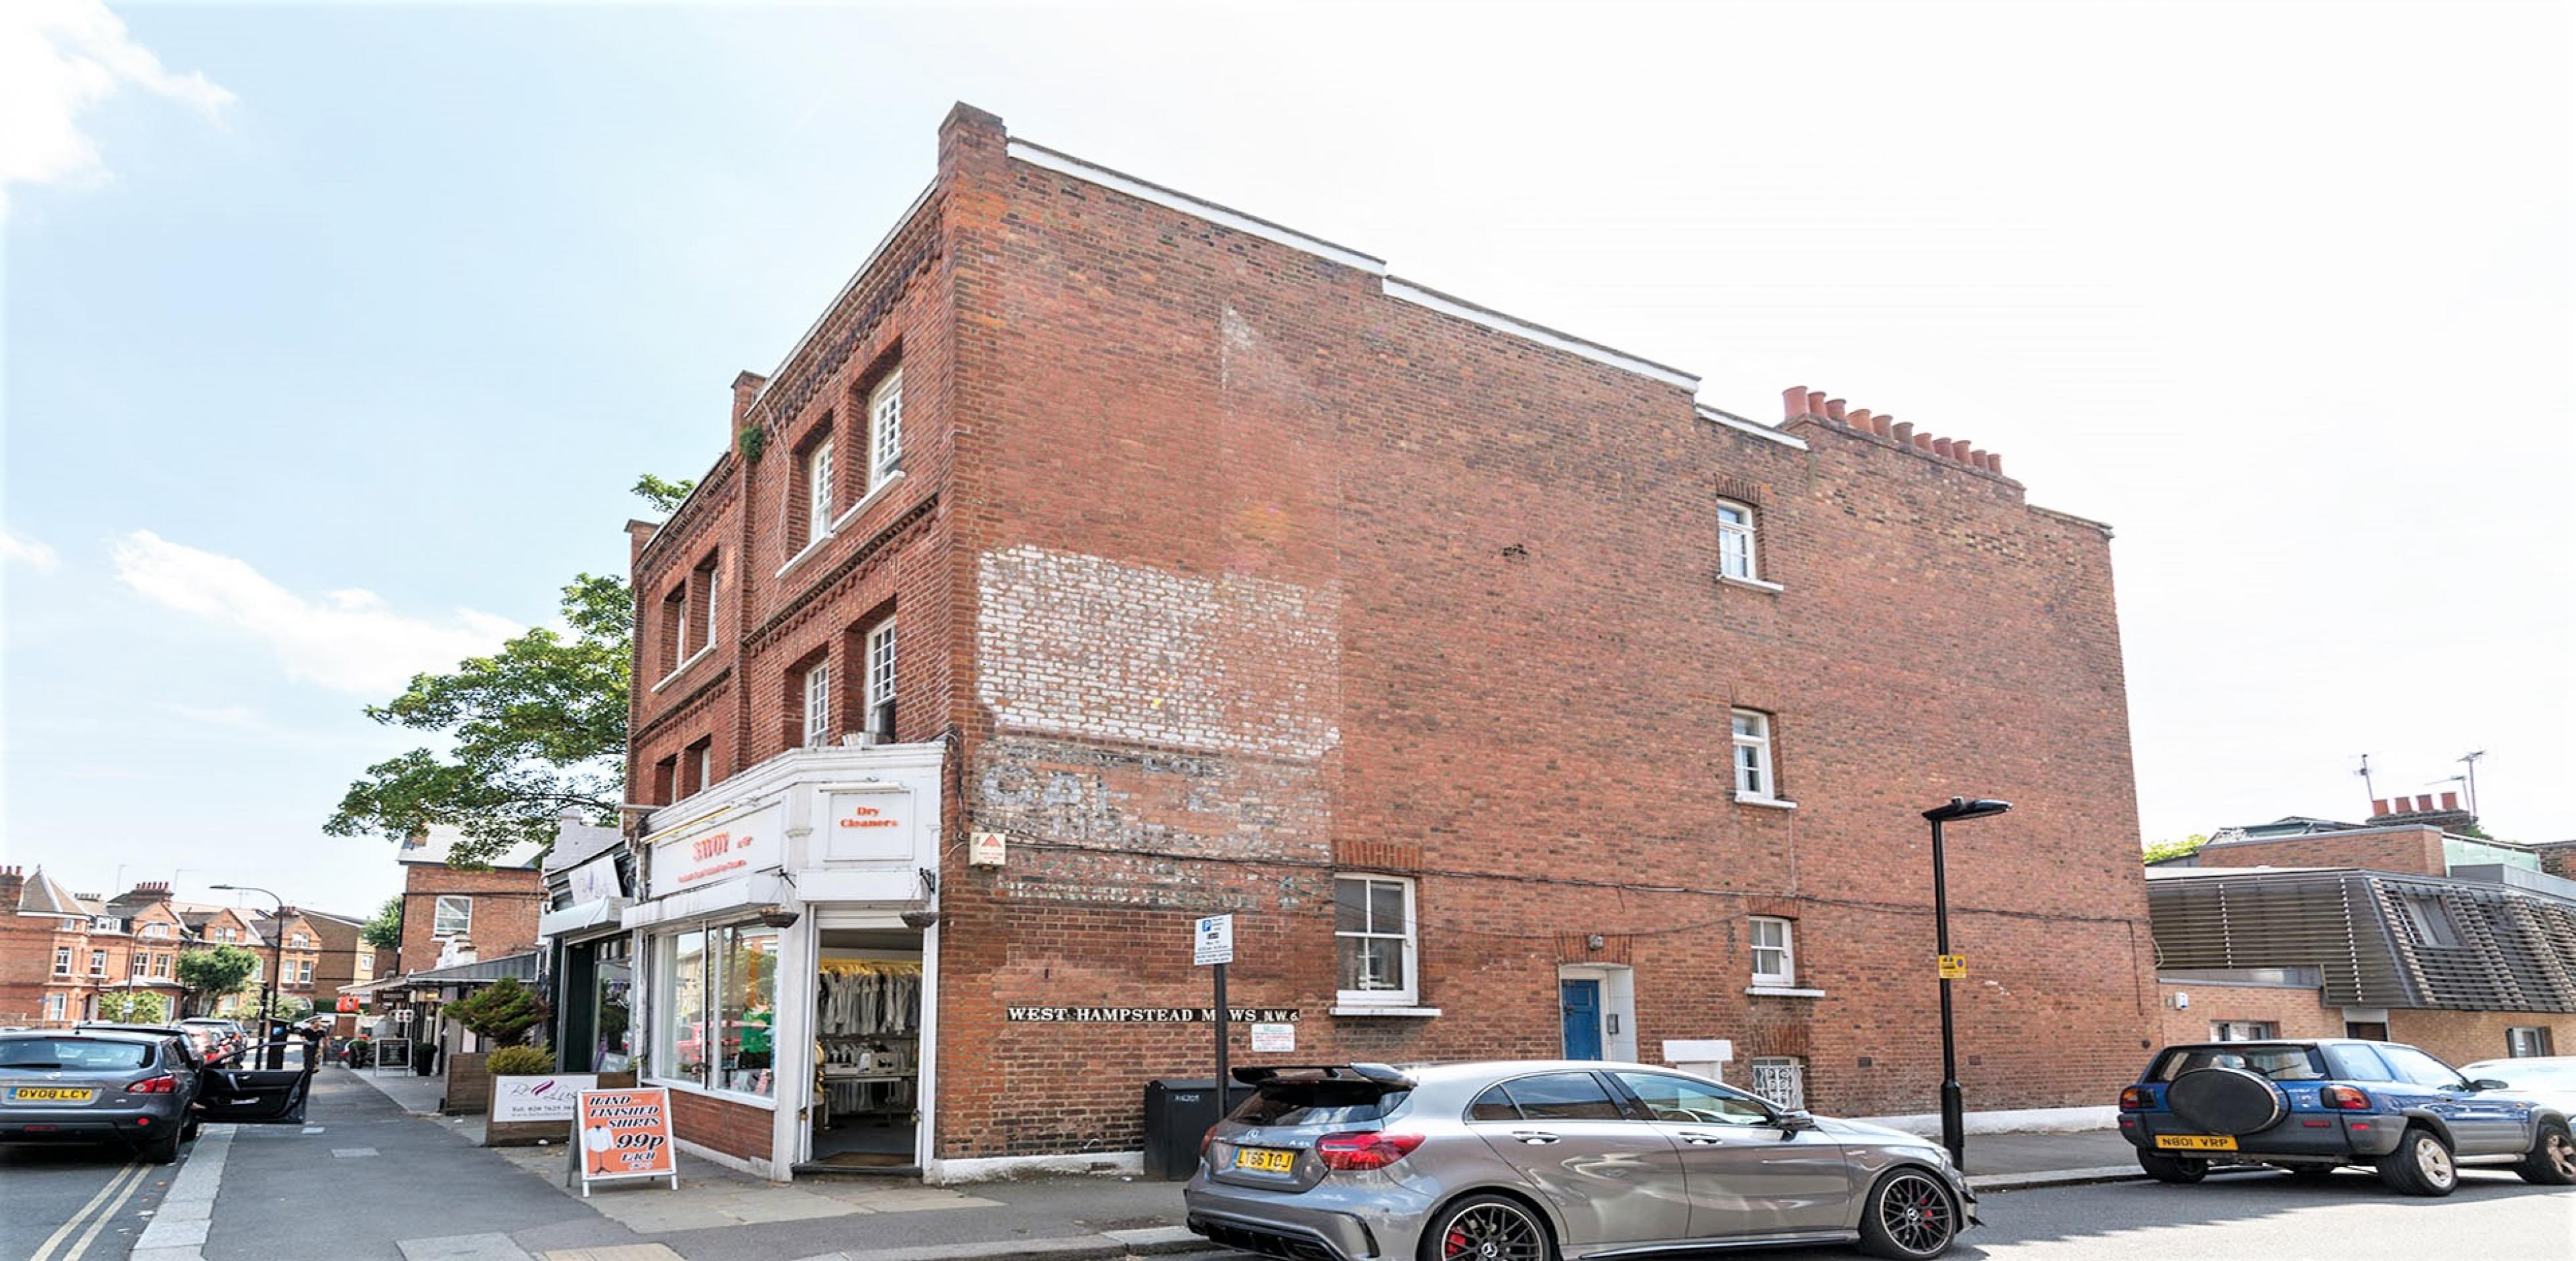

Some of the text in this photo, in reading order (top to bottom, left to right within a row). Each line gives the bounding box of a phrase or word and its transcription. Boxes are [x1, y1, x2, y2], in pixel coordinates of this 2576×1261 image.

[857, 807, 880, 816] Dry
[840, 818, 899, 828] Cleaners
[1008, 1007, 1068, 1021] WEST
[1076, 1007, 1194, 1022] HAMPSTEAD
[1201, 1008, 1257, 1022] MWS
[60, 1090, 90, 1098] LCY
[589, 1096, 632, 1106] HAND
[590, 1105, 660, 1118] FINISHED
[608, 1117, 660, 1128] SHIRTS
[616, 1133, 665, 1151] 99p
[2200, 1138, 2228, 1147] VRP
[621, 1151, 656, 1162] EACH
